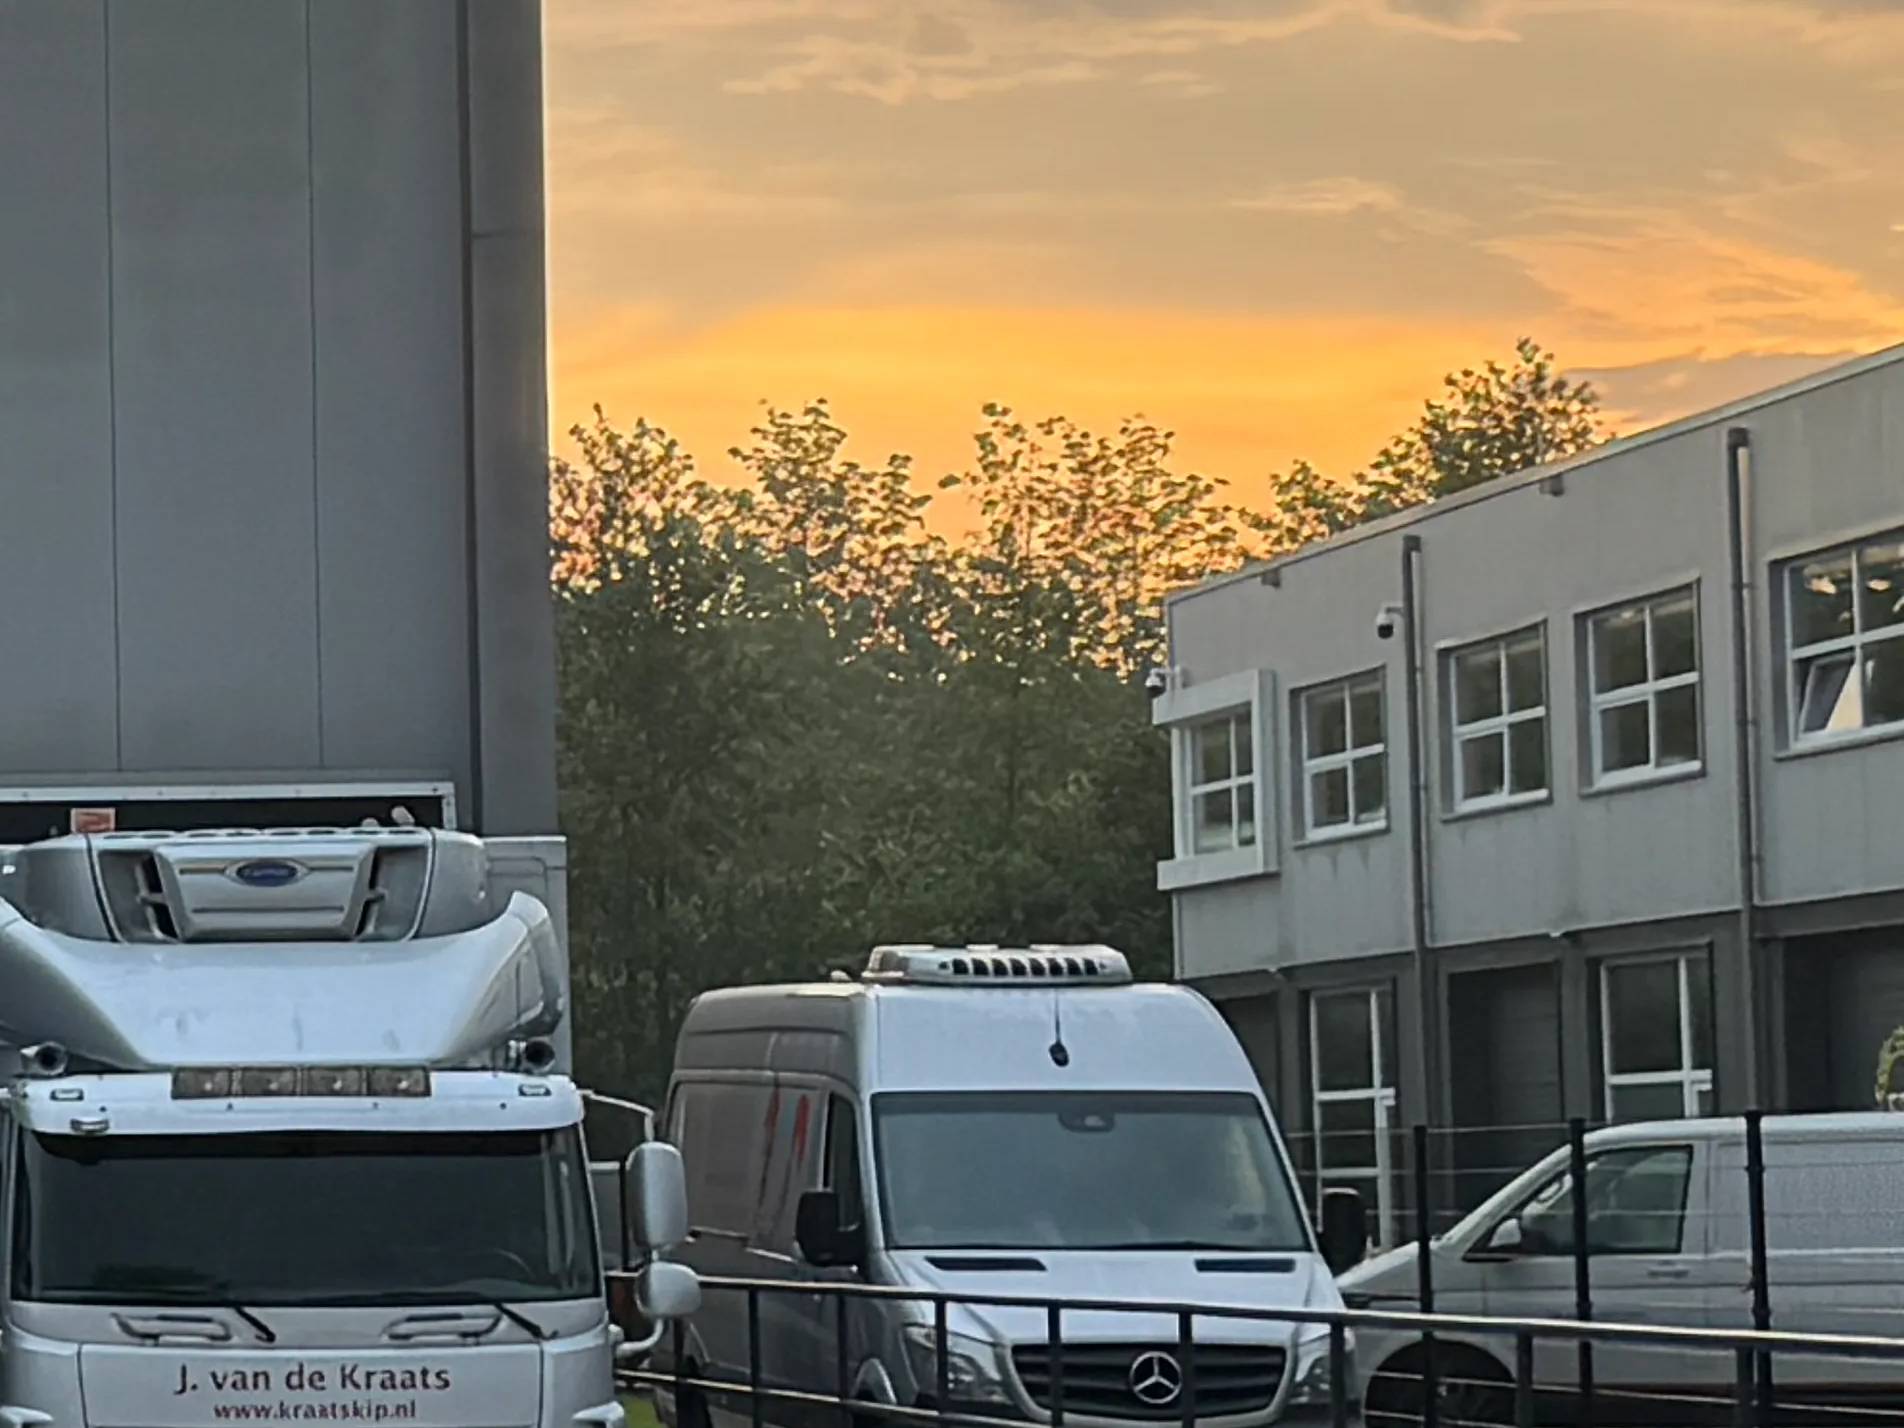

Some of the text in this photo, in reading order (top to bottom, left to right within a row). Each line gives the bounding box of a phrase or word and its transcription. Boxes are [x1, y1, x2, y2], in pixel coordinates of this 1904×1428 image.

[173, 1362, 452, 1395] J. van de Kraats
[213, 1400, 417, 1422] www.kraatskip.nl
